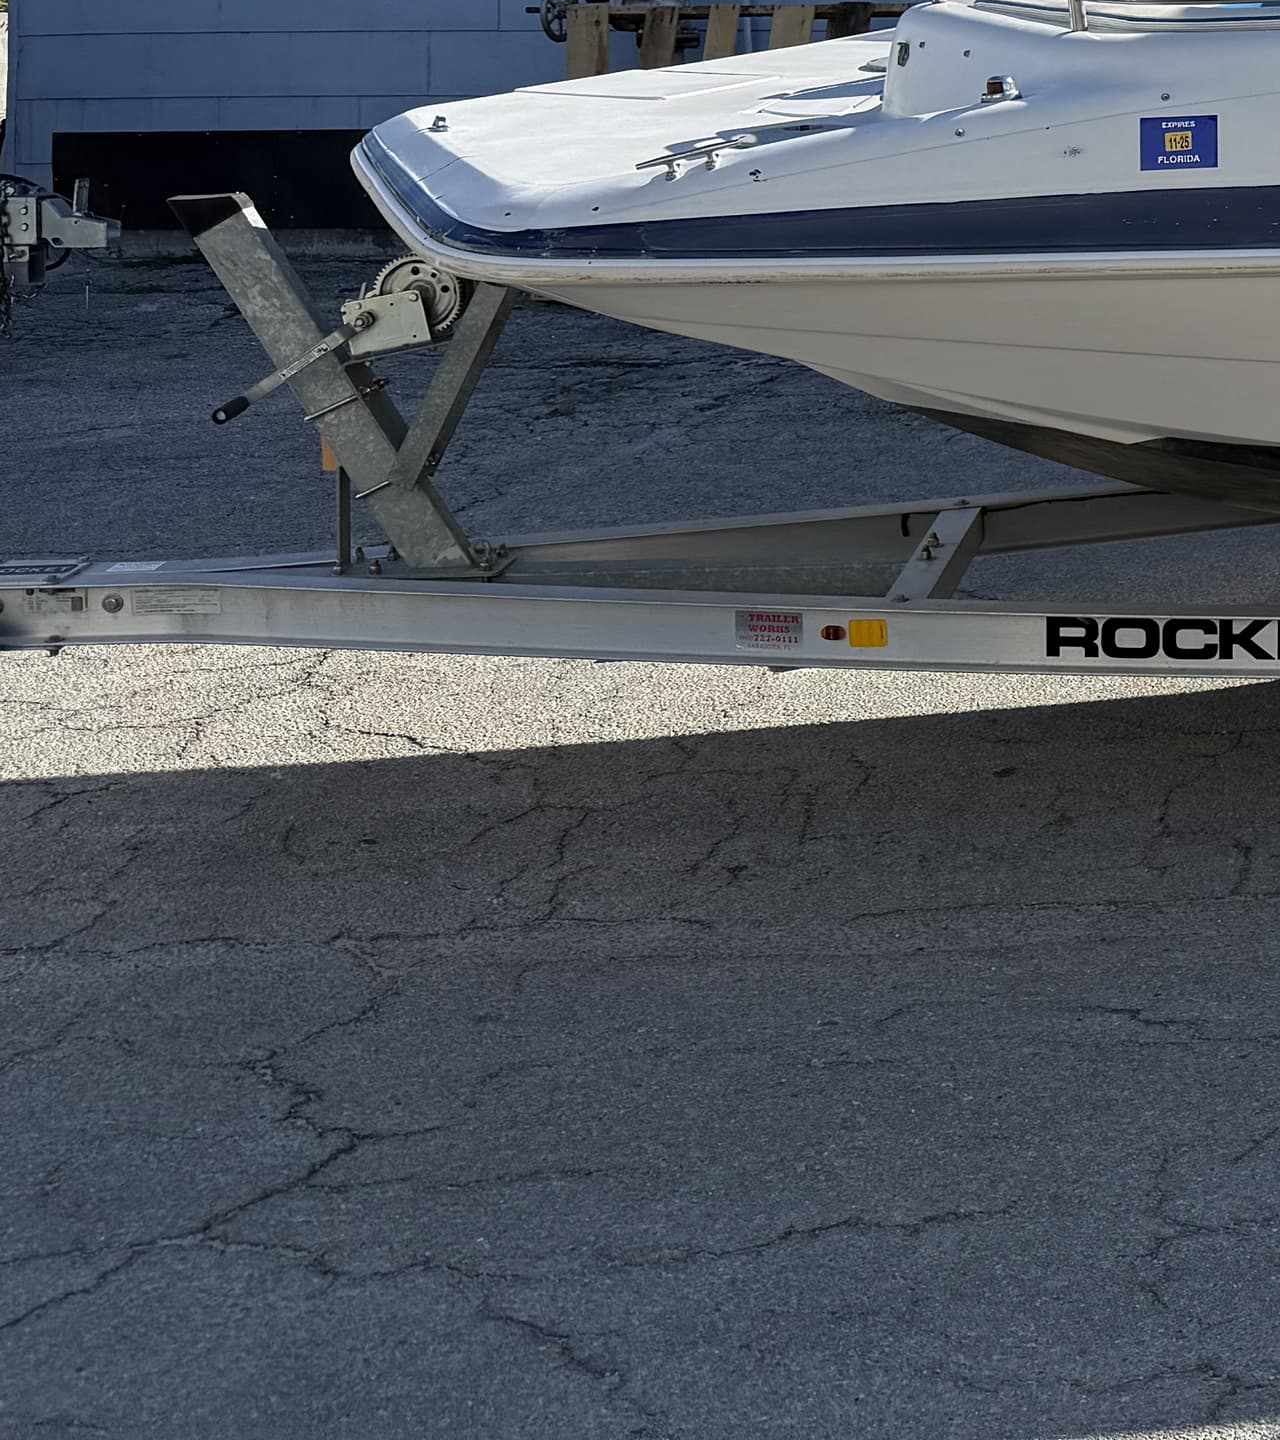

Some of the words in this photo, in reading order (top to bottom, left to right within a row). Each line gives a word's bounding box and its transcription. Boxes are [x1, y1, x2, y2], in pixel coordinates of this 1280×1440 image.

[1161, 120, 1196, 129] EXPIRES
[1168, 135, 1190, 150] 11-25
[1157, 154, 1201, 164] FLORIDA
[748, 613, 800, 624] TRAILER
